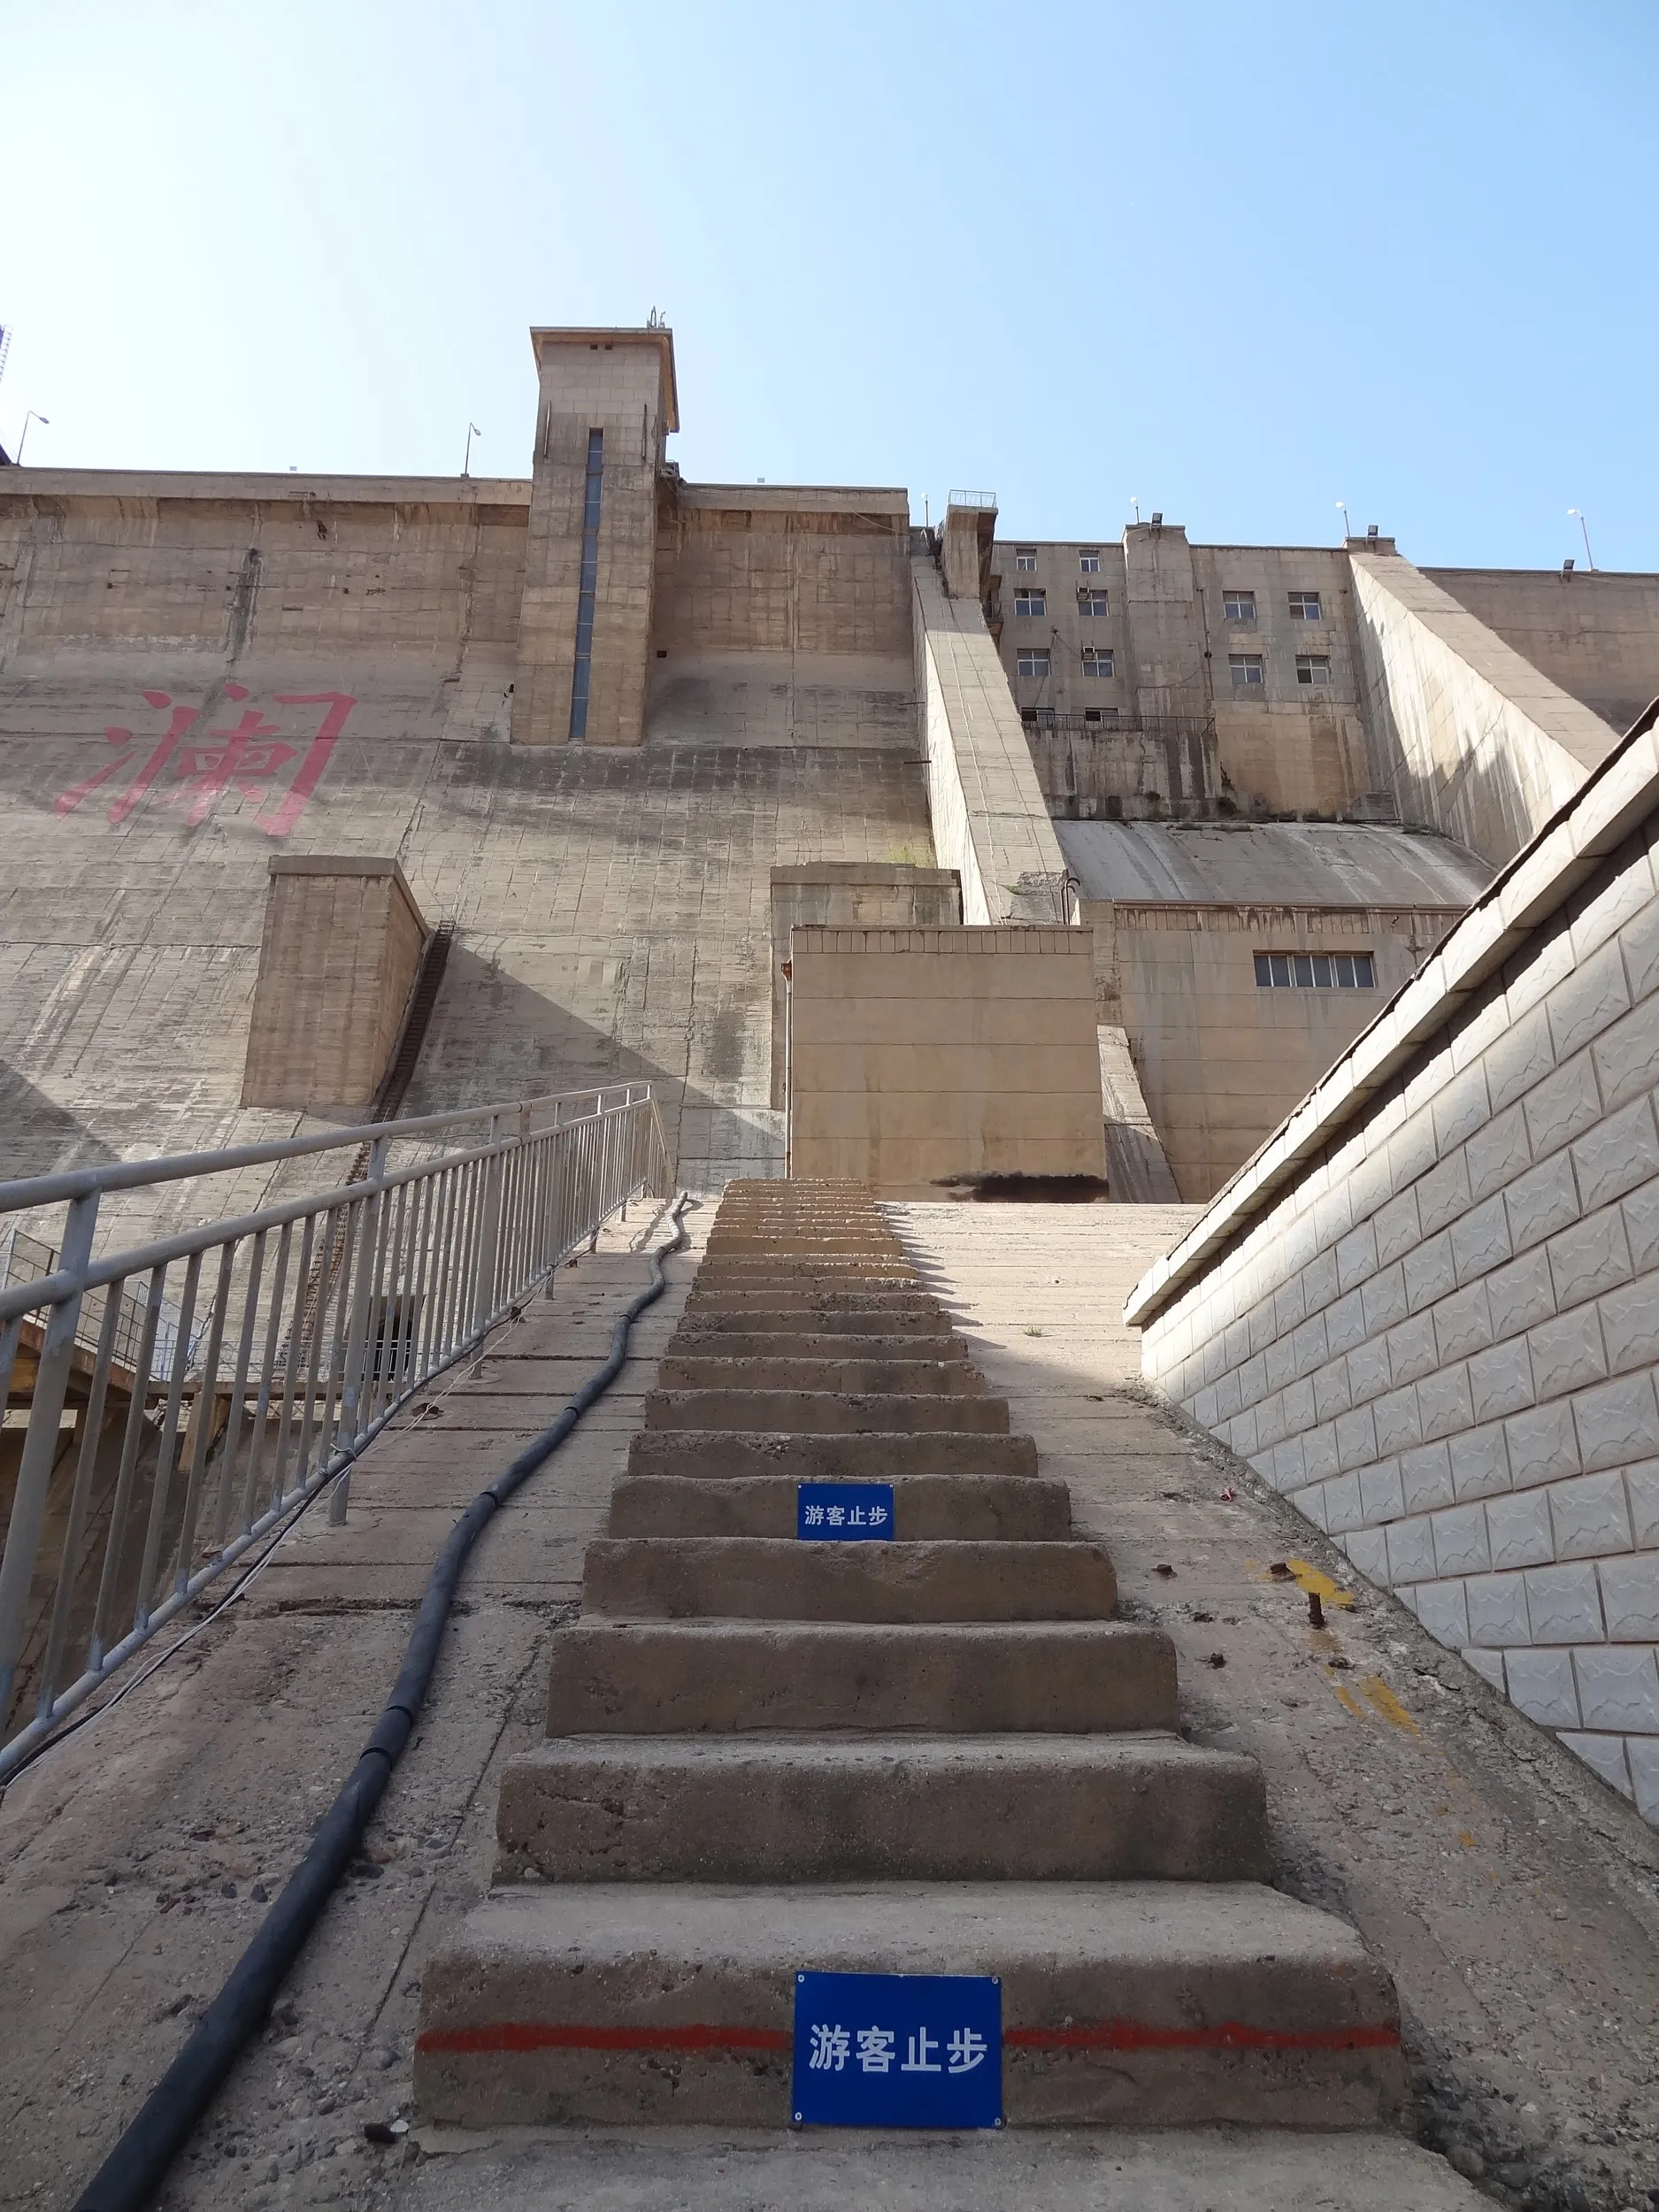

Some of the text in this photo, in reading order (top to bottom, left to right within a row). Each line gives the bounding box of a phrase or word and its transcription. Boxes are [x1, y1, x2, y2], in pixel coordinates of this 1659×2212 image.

[804, 1505, 888, 1526] 游客止步
[809, 2024, 987, 2074] 游客止步
